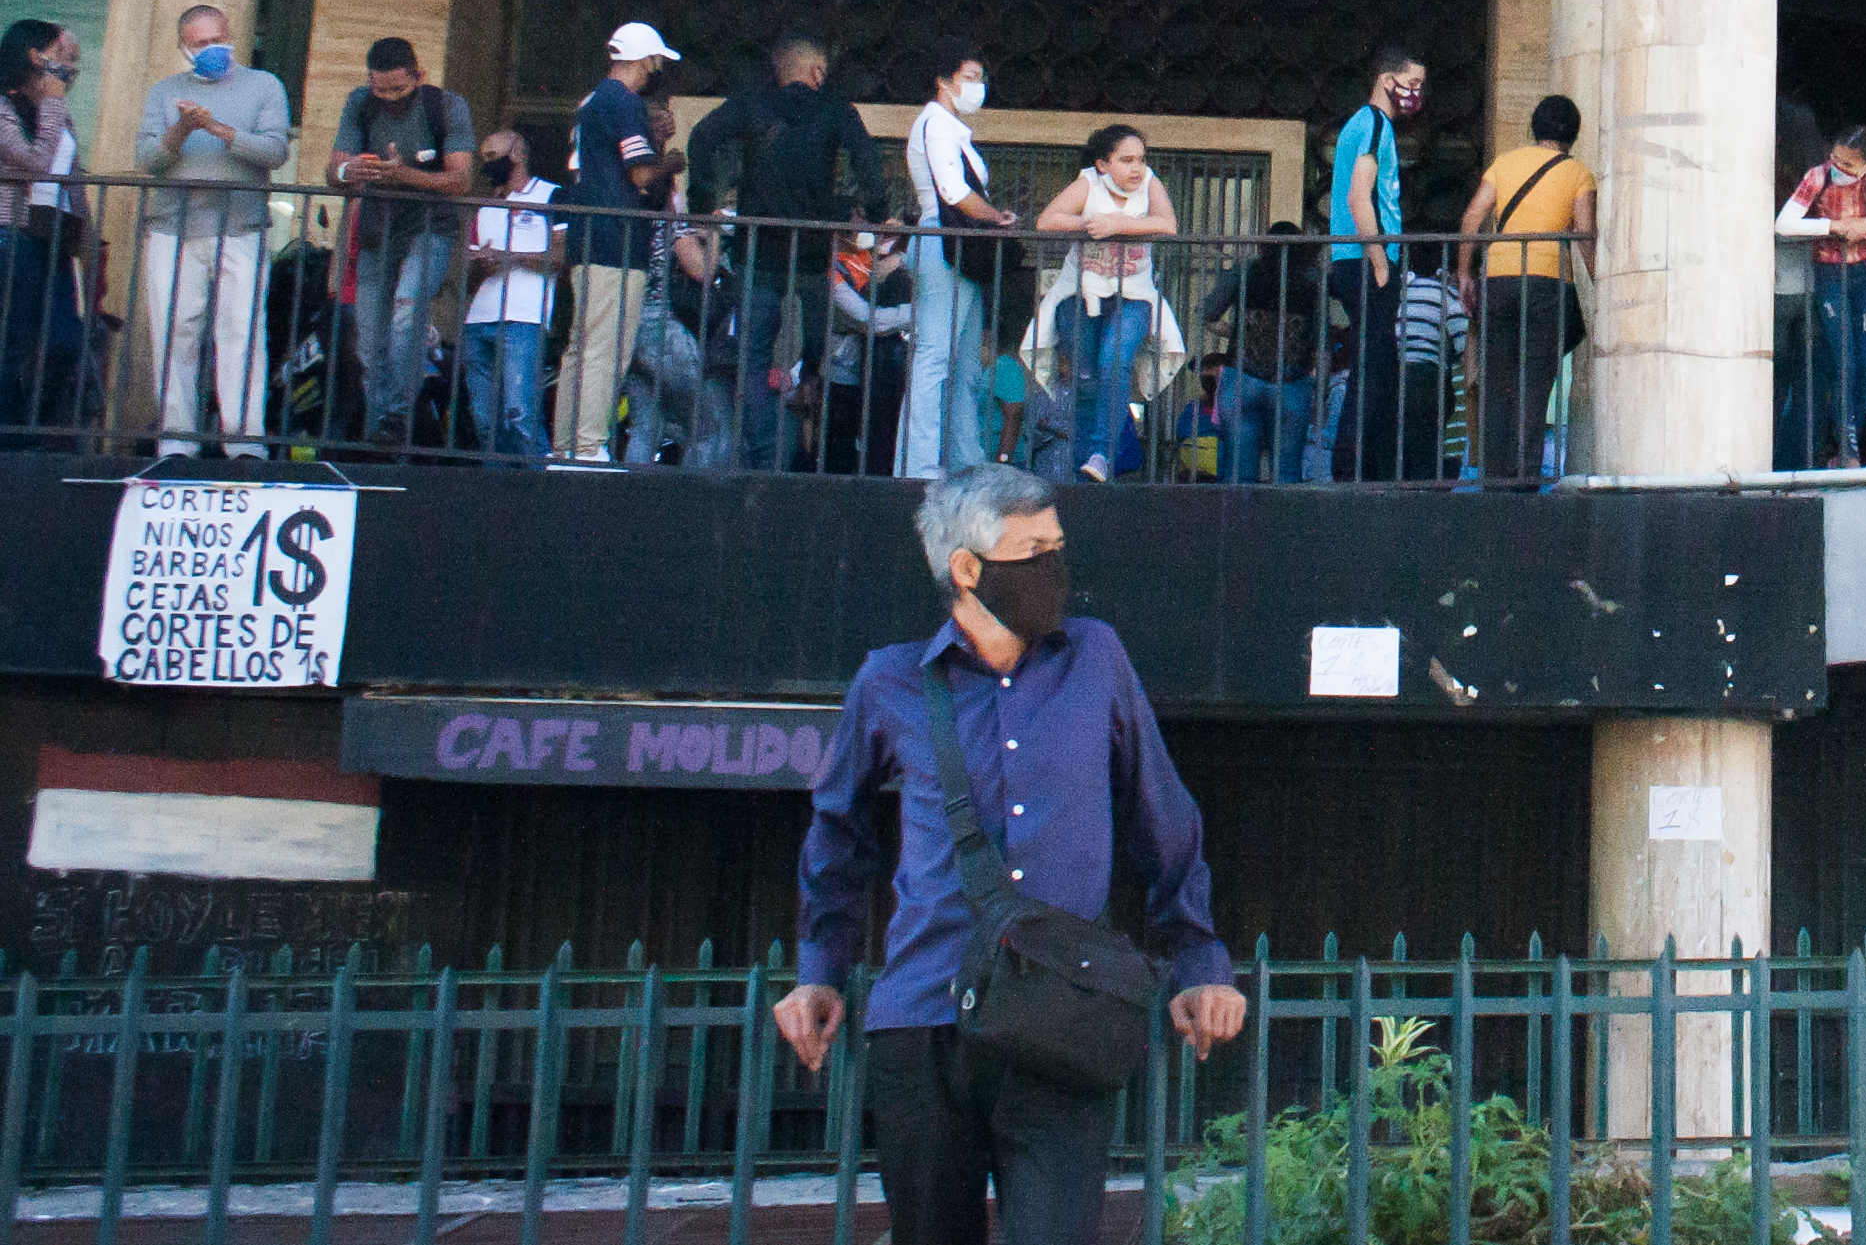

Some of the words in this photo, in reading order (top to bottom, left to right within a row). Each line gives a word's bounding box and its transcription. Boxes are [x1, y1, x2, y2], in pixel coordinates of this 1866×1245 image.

[141, 487, 250, 513] CORTES
[144, 518, 234, 548] NIÑOS
[132, 550, 247, 578] BARBAS
[240, 505, 335, 613] 1$
[126, 581, 229, 611] CEJAS
[121, 613, 258, 649] CORTES
[270, 613, 316, 650] DE
[116, 648, 284, 682] CABELLOS
[436, 714, 600, 772] CAFE
[627, 722, 822, 775] MOLIDO
